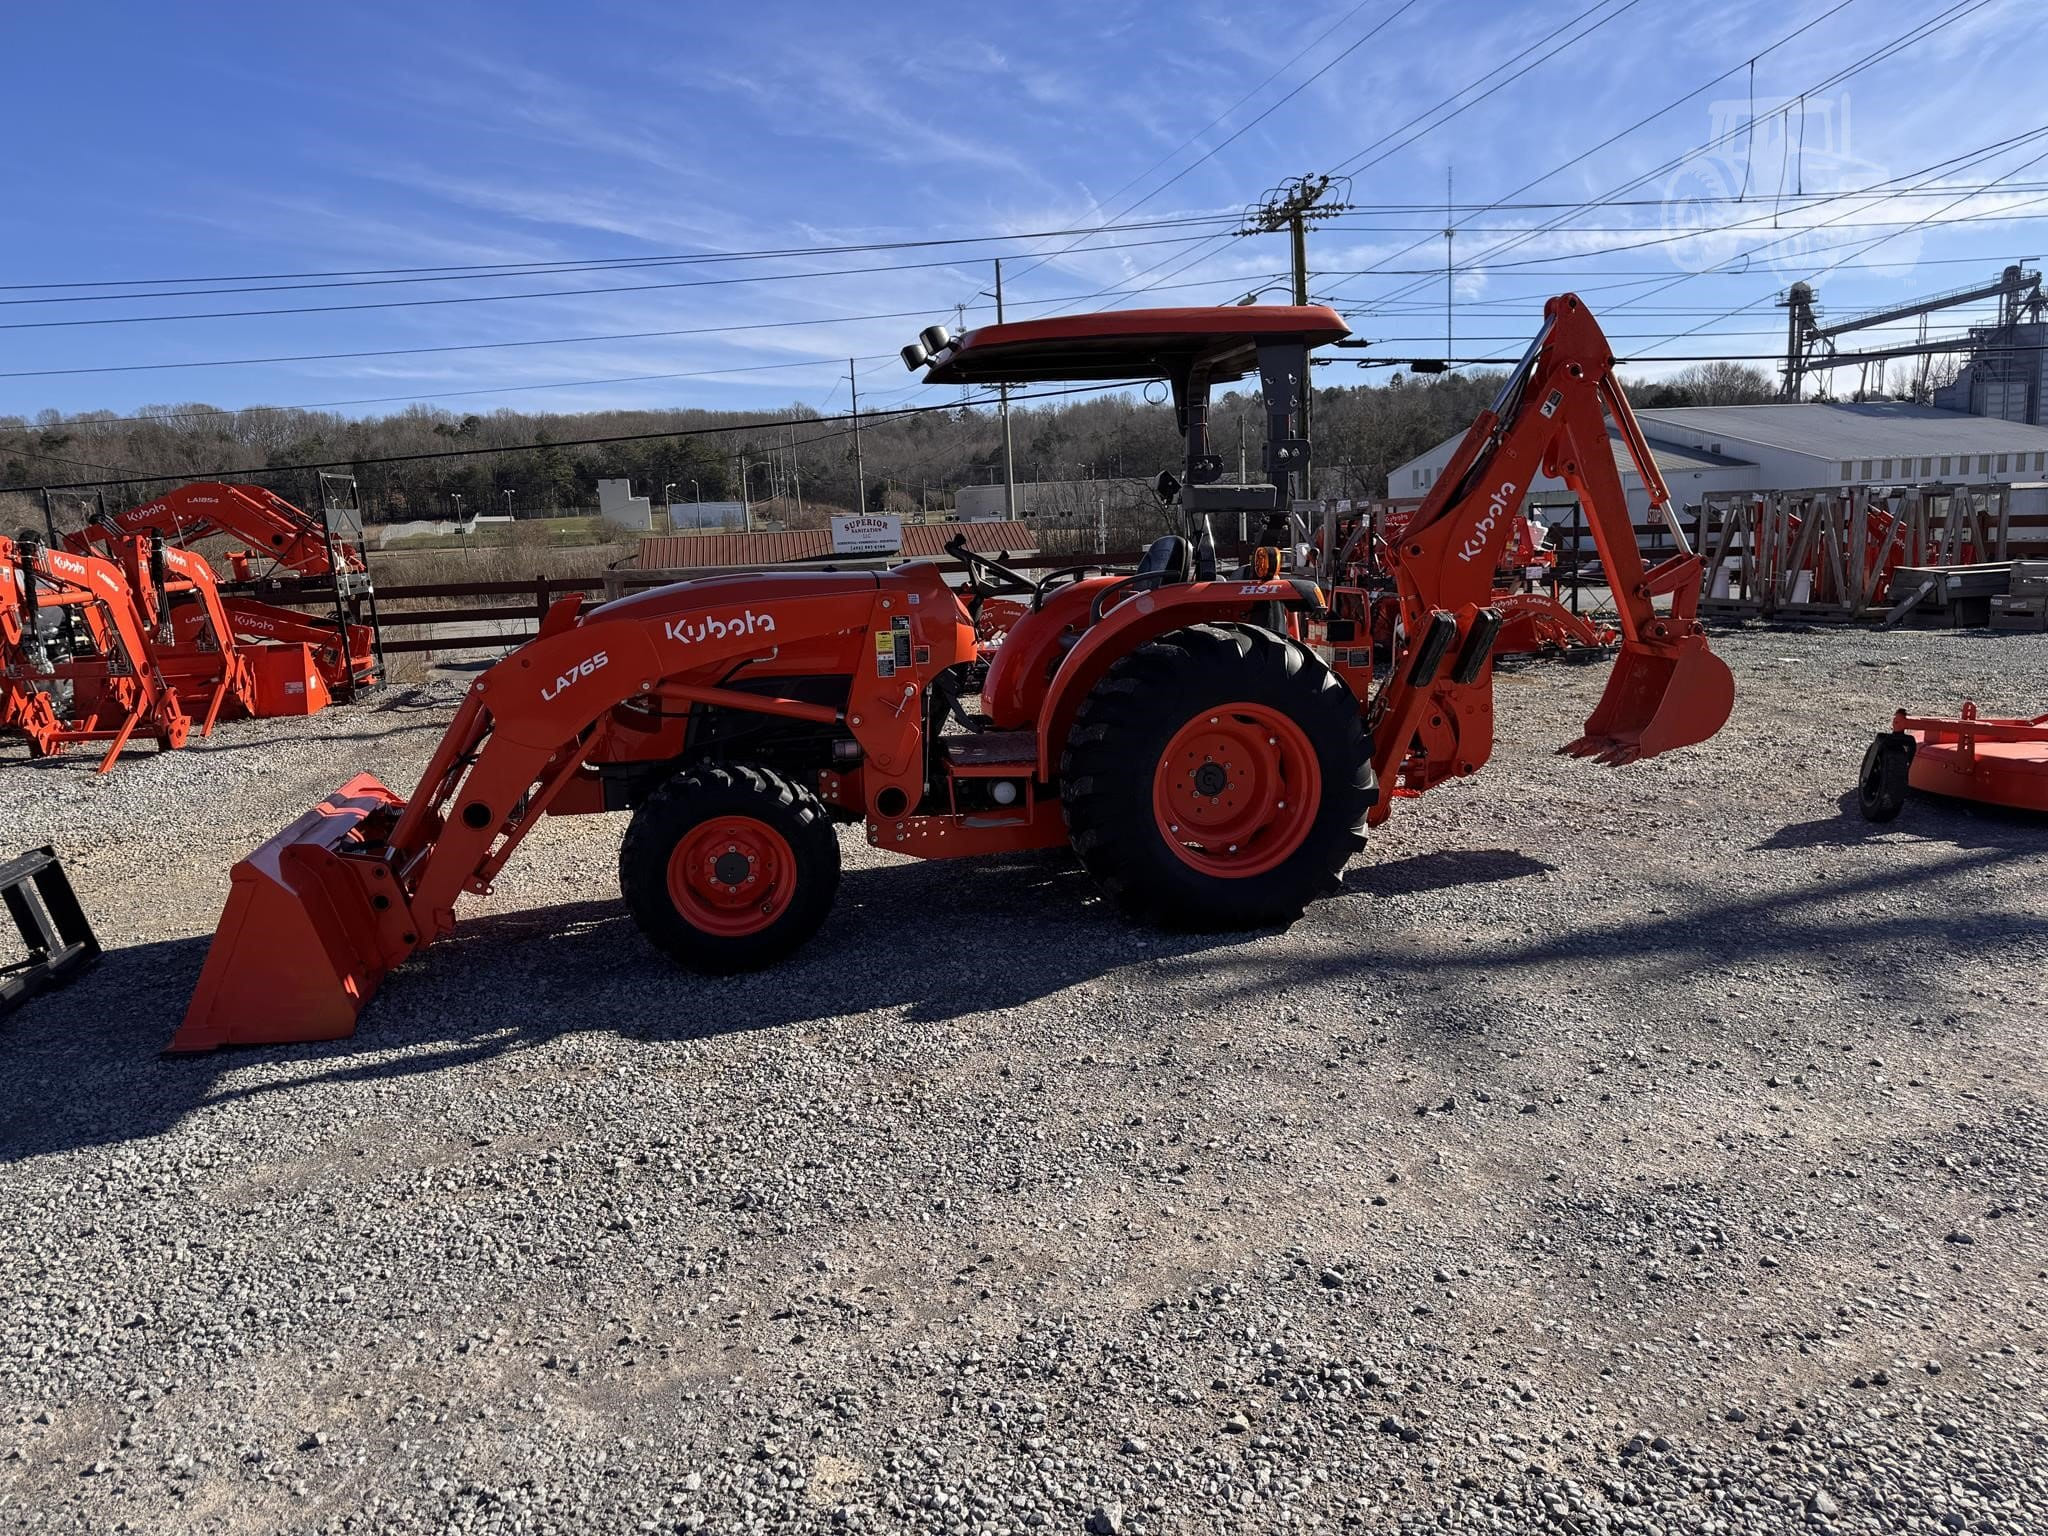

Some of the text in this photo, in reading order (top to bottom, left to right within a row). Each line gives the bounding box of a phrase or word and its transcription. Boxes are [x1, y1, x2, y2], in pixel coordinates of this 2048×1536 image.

[126, 503, 167, 521] Kubota
[844, 518, 888, 531] SUPERIOR
[1458, 482, 1516, 562] Kubota
[53, 555, 86, 575] Kubota
[1238, 584, 1283, 595] HST
[234, 614, 275, 631] Kubota
[664, 610, 776, 644] Kubota
[540, 650, 609, 701] LA765
